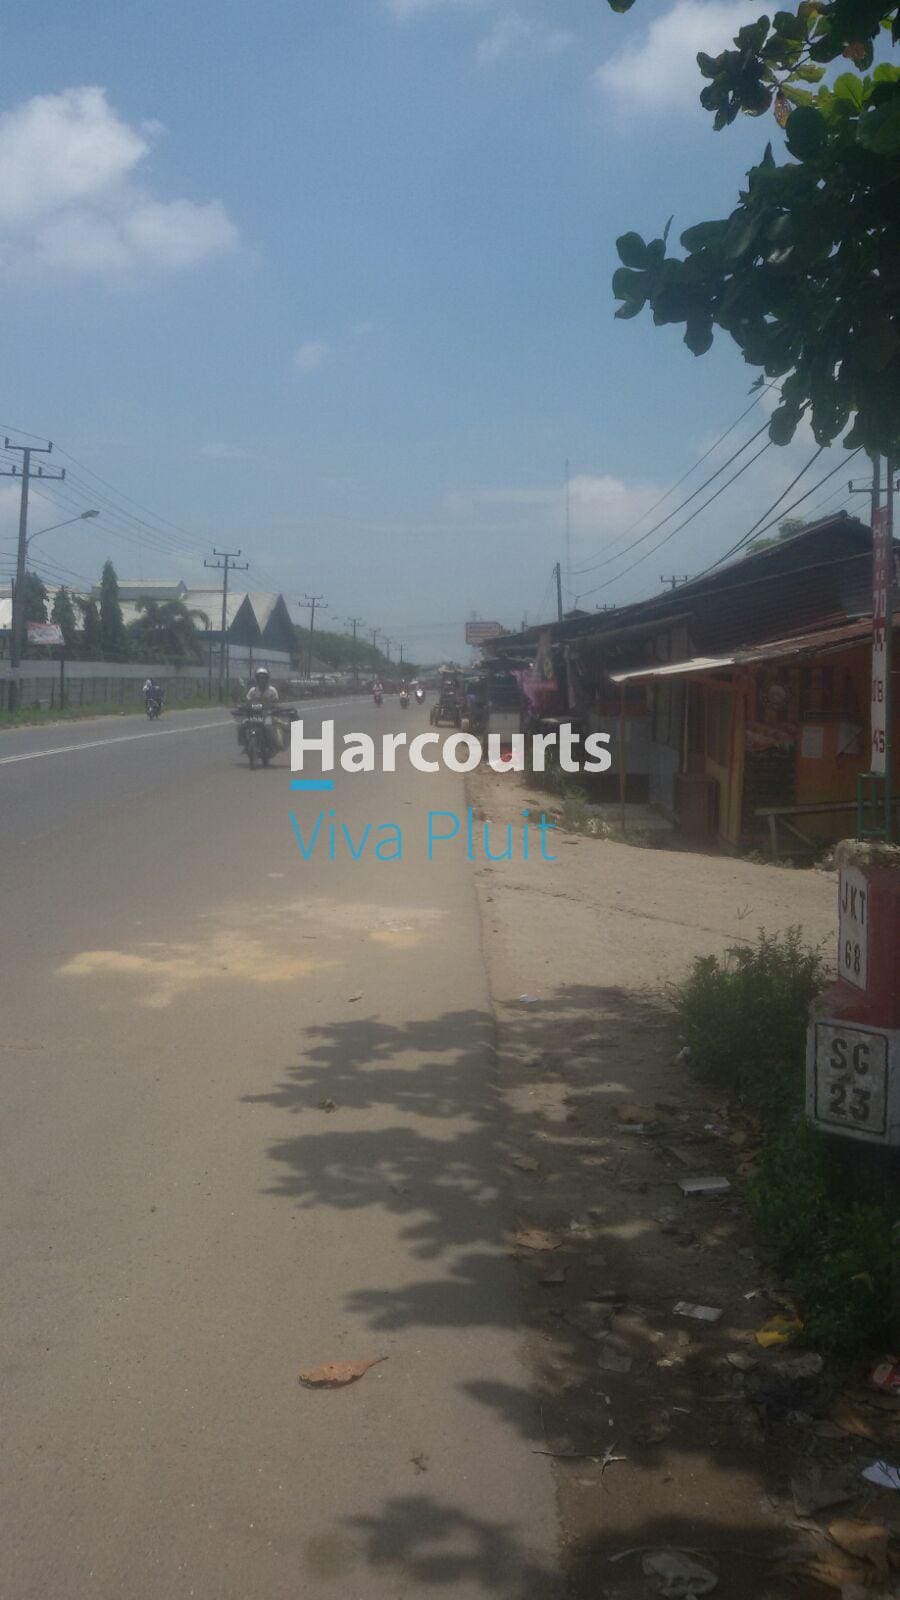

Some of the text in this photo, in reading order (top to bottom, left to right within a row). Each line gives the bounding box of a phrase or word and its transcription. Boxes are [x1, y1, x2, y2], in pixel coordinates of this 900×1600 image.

[841, 880, 866, 925] JKT
[845, 941, 861, 976] 68
[830, 1038, 871, 1076] SC
